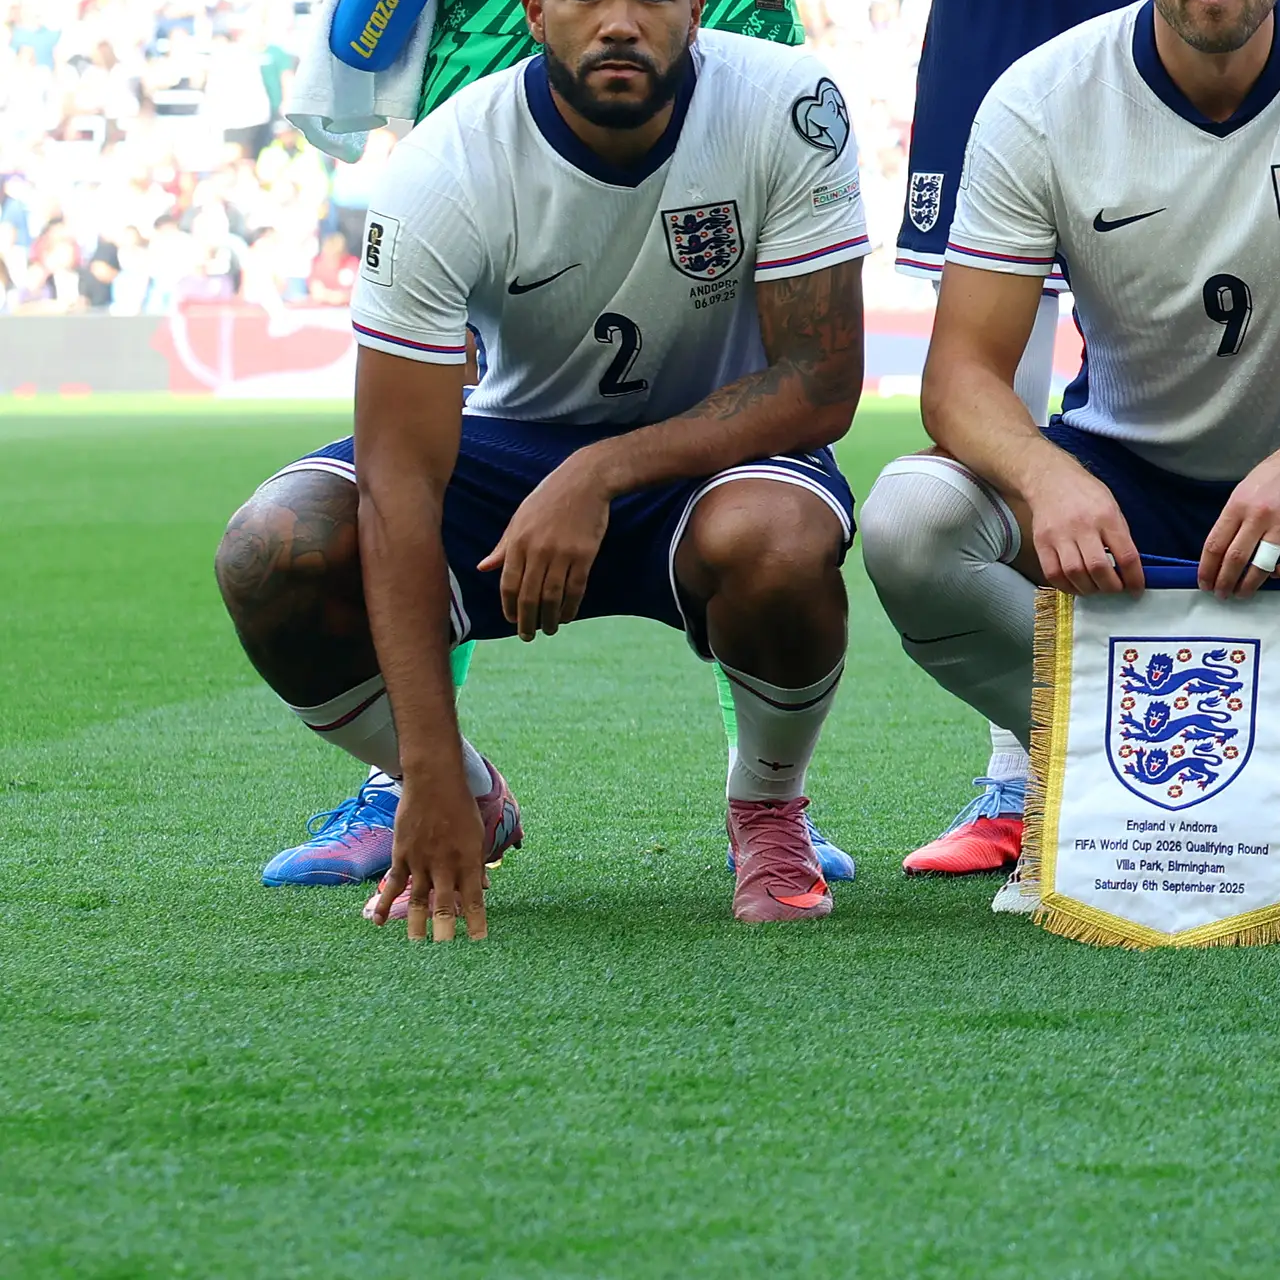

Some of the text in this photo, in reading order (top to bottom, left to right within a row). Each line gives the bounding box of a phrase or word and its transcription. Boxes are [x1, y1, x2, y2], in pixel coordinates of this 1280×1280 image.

[813, 181, 859, 205] FOUNDATIO
[695, 289, 735, 309] 06.09.25
[1202, 274, 1253, 357] 9
[593, 312, 649, 398] 2
[1126, 819, 1219, 833] England v Andorra
[1075, 839, 1269, 856] FIFA World Cup 2026 Qualifying Round
[1116, 858, 1225, 875] Villa Park, Birmingham
[1094, 878, 1245, 894] Saturday 6th September 2025
